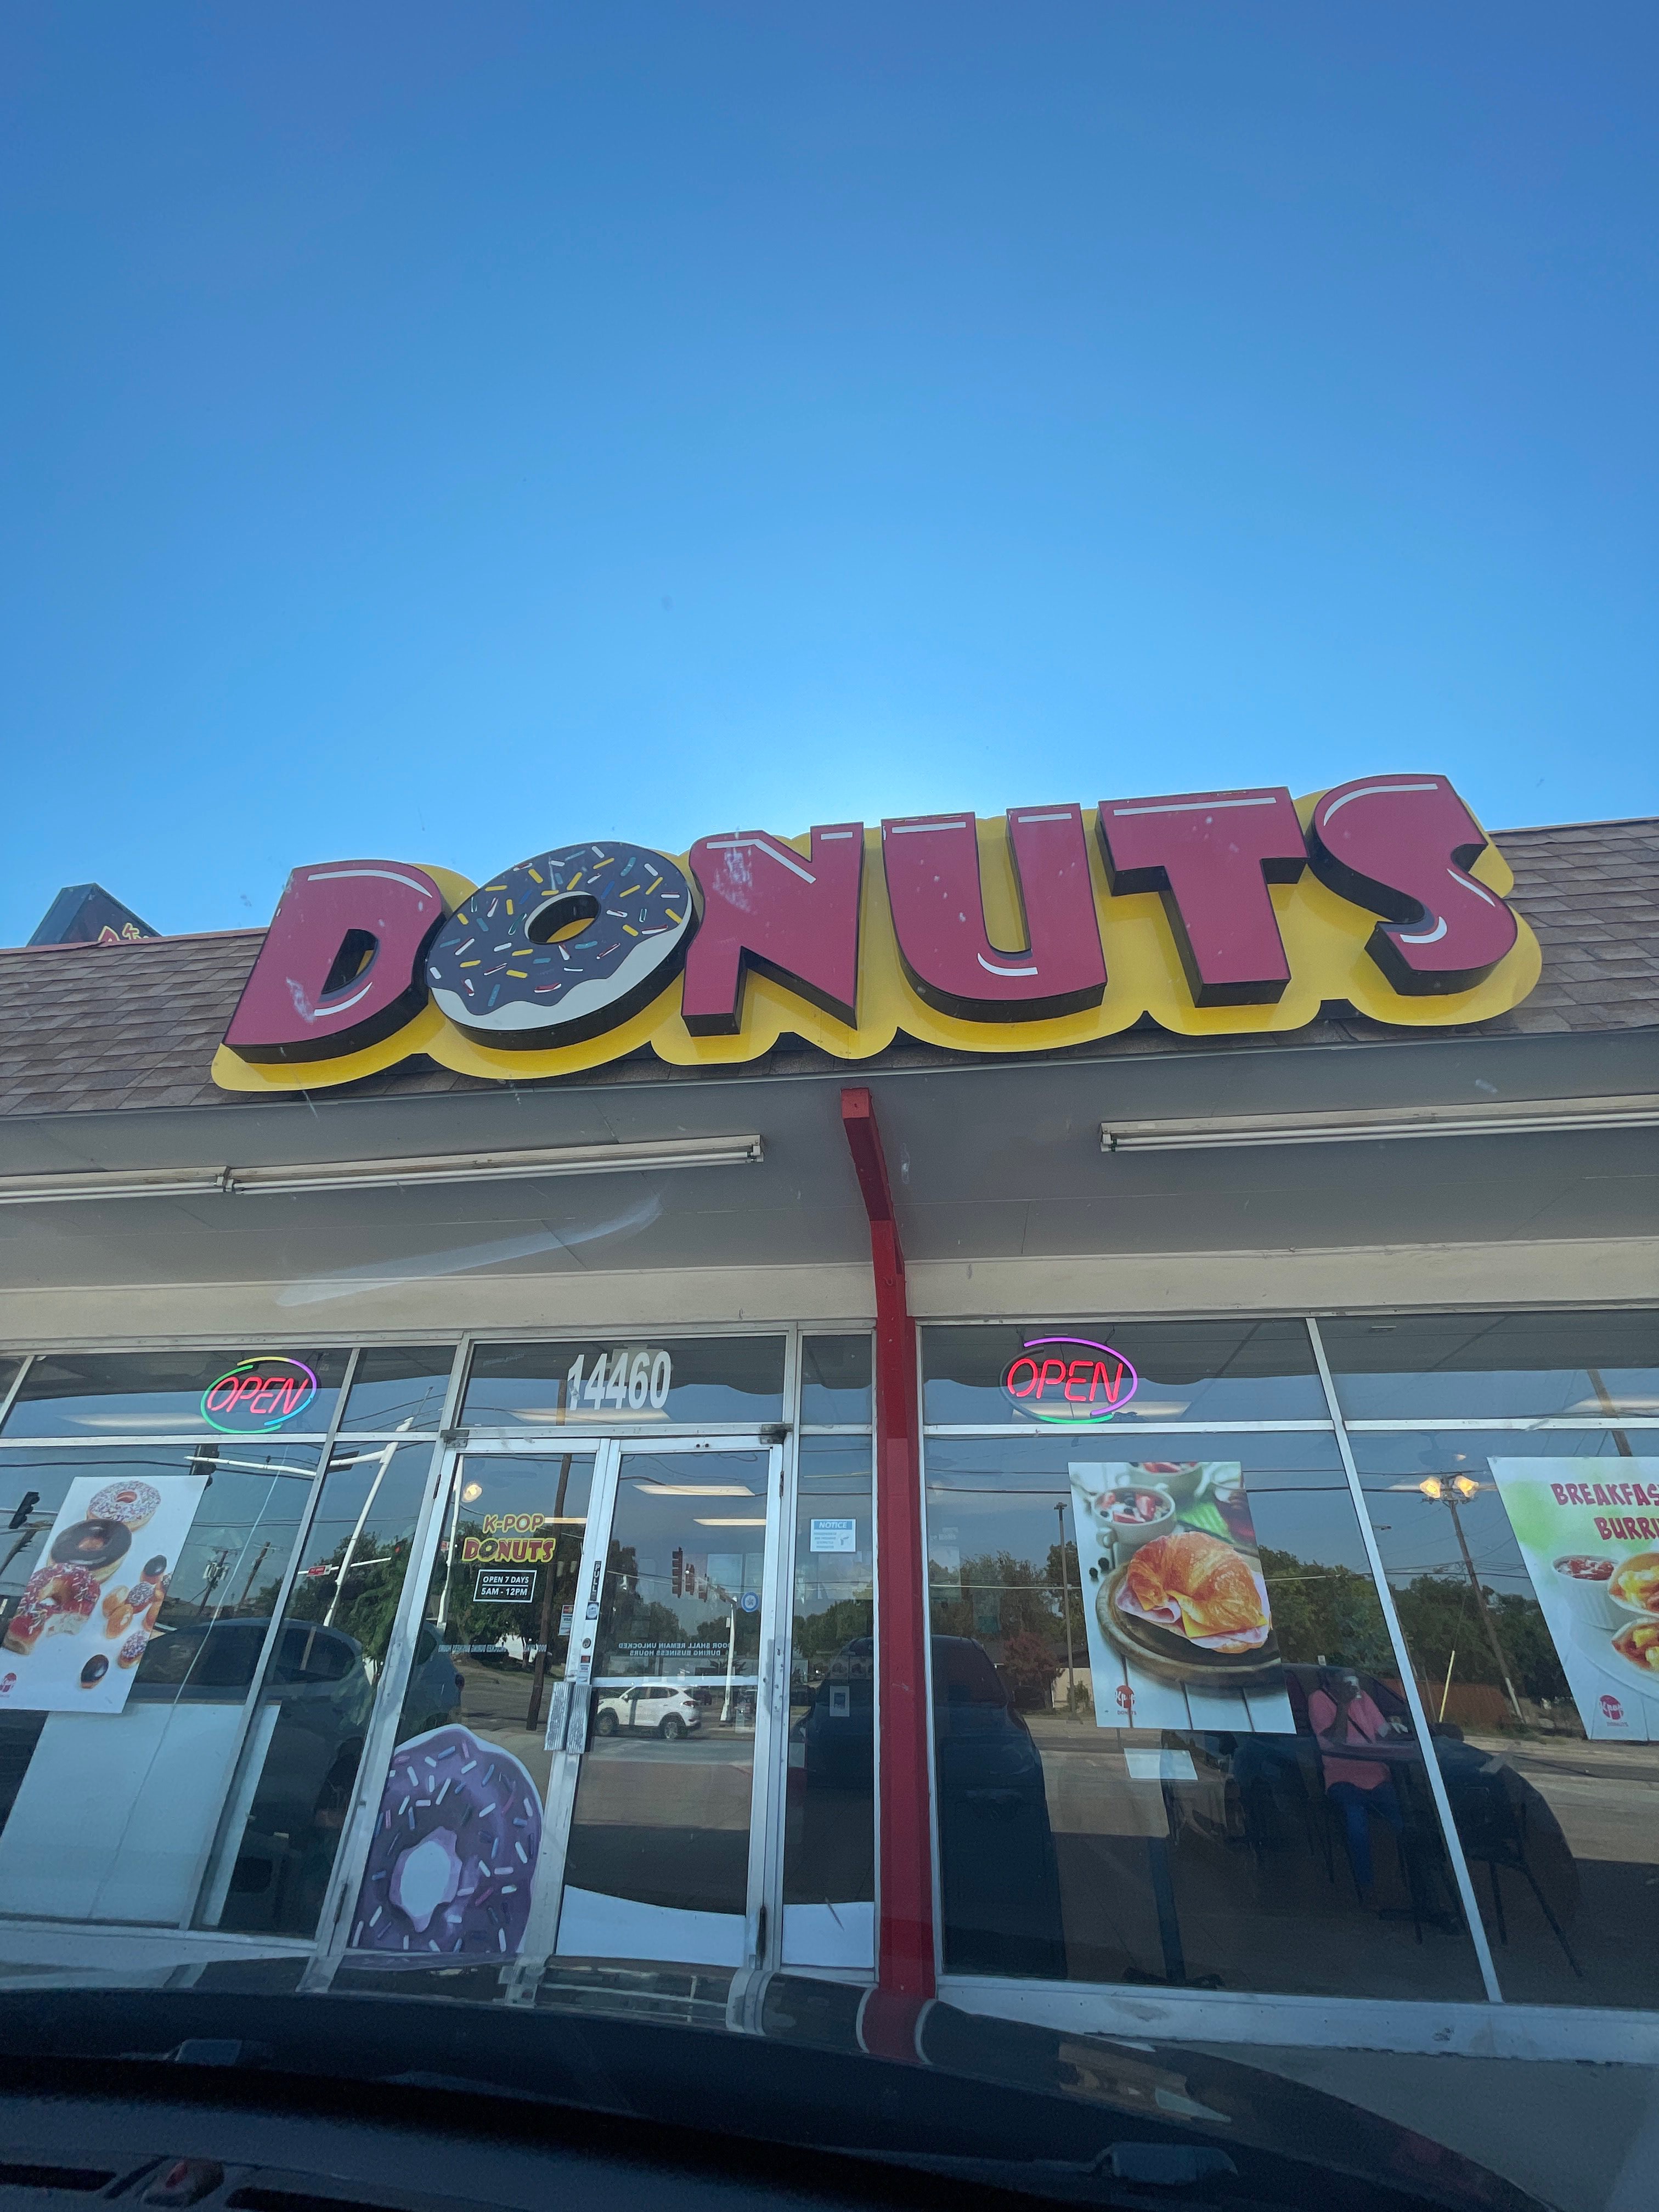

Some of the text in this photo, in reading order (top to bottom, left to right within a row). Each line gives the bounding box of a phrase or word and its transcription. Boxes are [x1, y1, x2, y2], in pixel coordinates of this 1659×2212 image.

[221, 774, 1520, 1063] DONUTS
[567, 1351, 671, 1410] 14460
[1007, 1358, 1123, 1403] OPEN
[207, 1376, 309, 1414] OPEN
[1550, 1483, 1659, 1506] BREAKFAS
[483, 1514, 544, 1533] K-POP
[1594, 1517, 1659, 1539] BURRI
[463, 1538, 555, 1562] DONUTS
[592, 1564, 600, 1592] PULL
